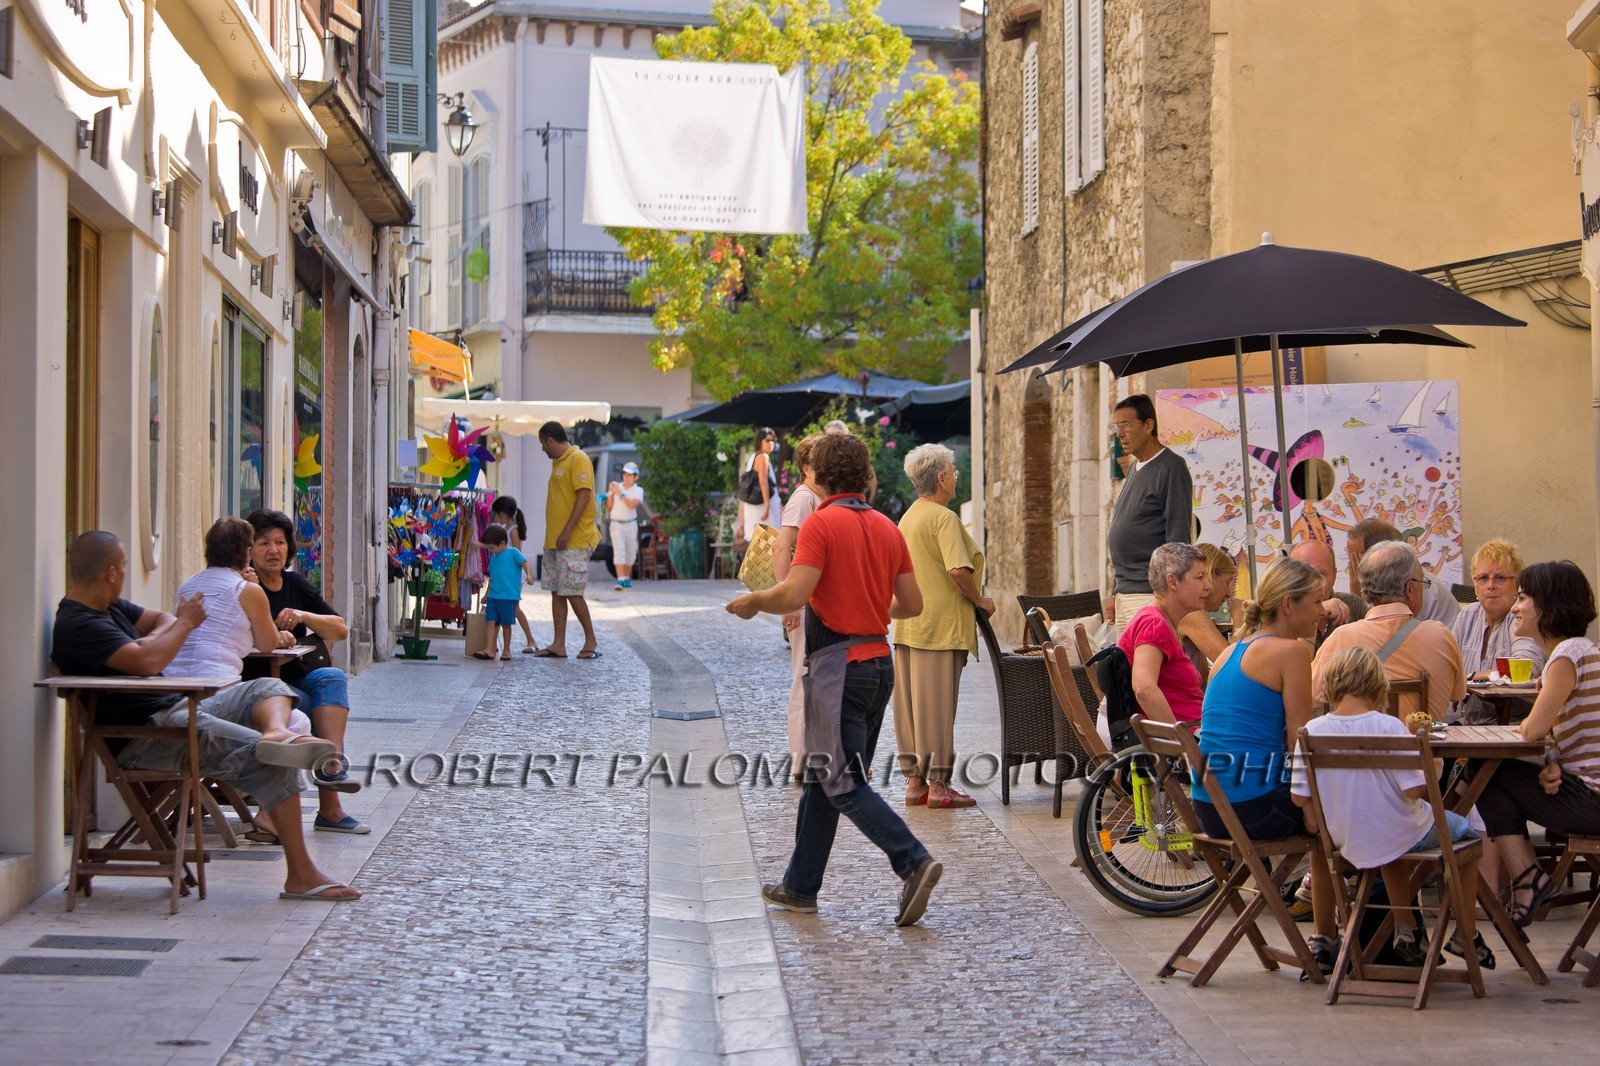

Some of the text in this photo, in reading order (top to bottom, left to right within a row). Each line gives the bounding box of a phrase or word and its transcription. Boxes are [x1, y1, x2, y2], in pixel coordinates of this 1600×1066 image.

[634, 71, 649, 80] LA
[657, 72, 700, 82] COLLE
[708, 75, 733, 84] SUR
